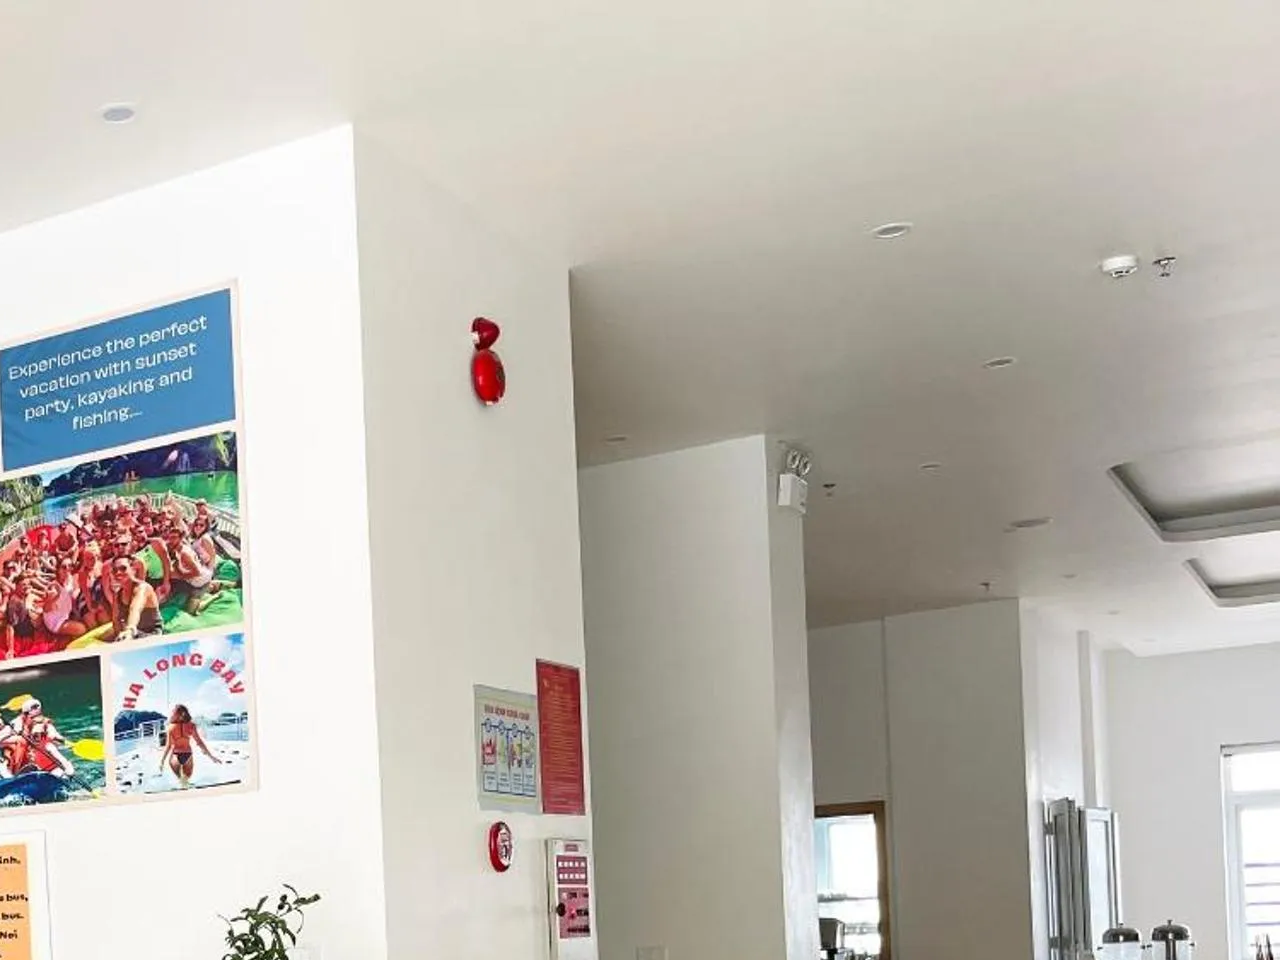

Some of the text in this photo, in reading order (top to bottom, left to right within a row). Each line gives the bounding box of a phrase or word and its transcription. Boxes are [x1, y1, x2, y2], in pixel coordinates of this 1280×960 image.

[9, 315, 208, 380] Experience the perfect
[19, 342, 198, 398] vacation with sunset
[24, 367, 193, 422] party, kayaking and
[123, 653, 245, 709] HA LONG BAY
